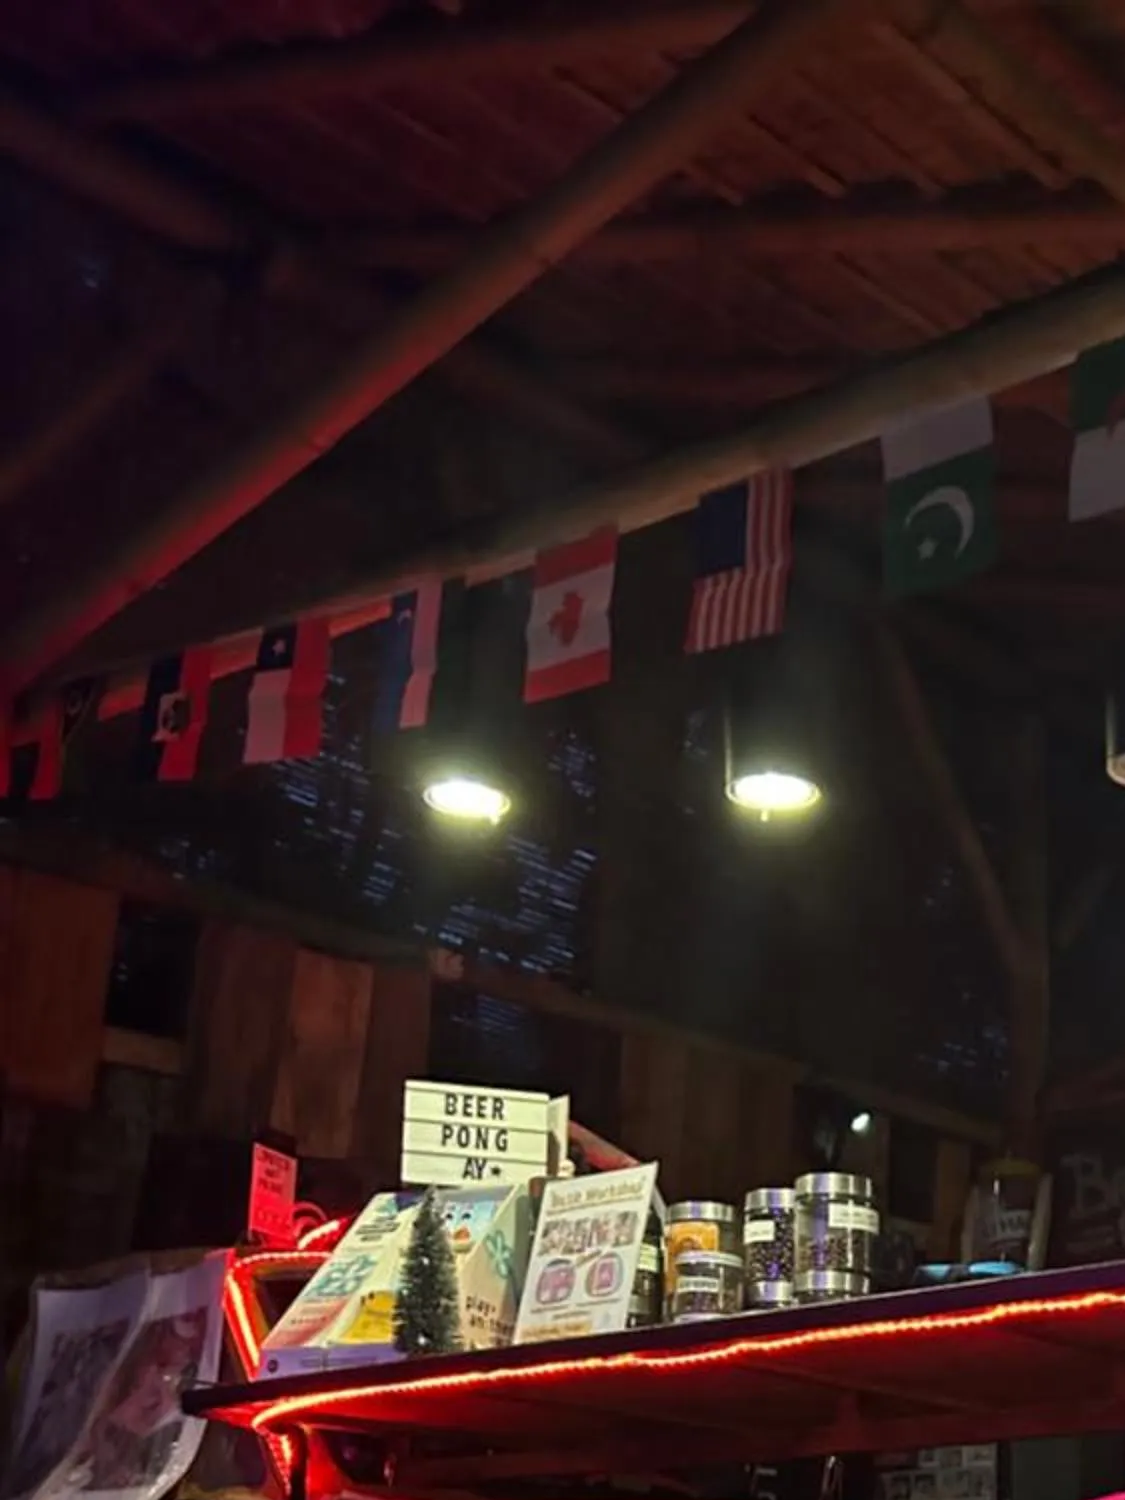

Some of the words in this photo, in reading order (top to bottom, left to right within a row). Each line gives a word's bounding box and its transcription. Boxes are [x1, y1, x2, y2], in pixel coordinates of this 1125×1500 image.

[444, 1093, 505, 1120] BEER
[441, 1124, 508, 1152] PONG
[462, 1157, 487, 1181] AY
